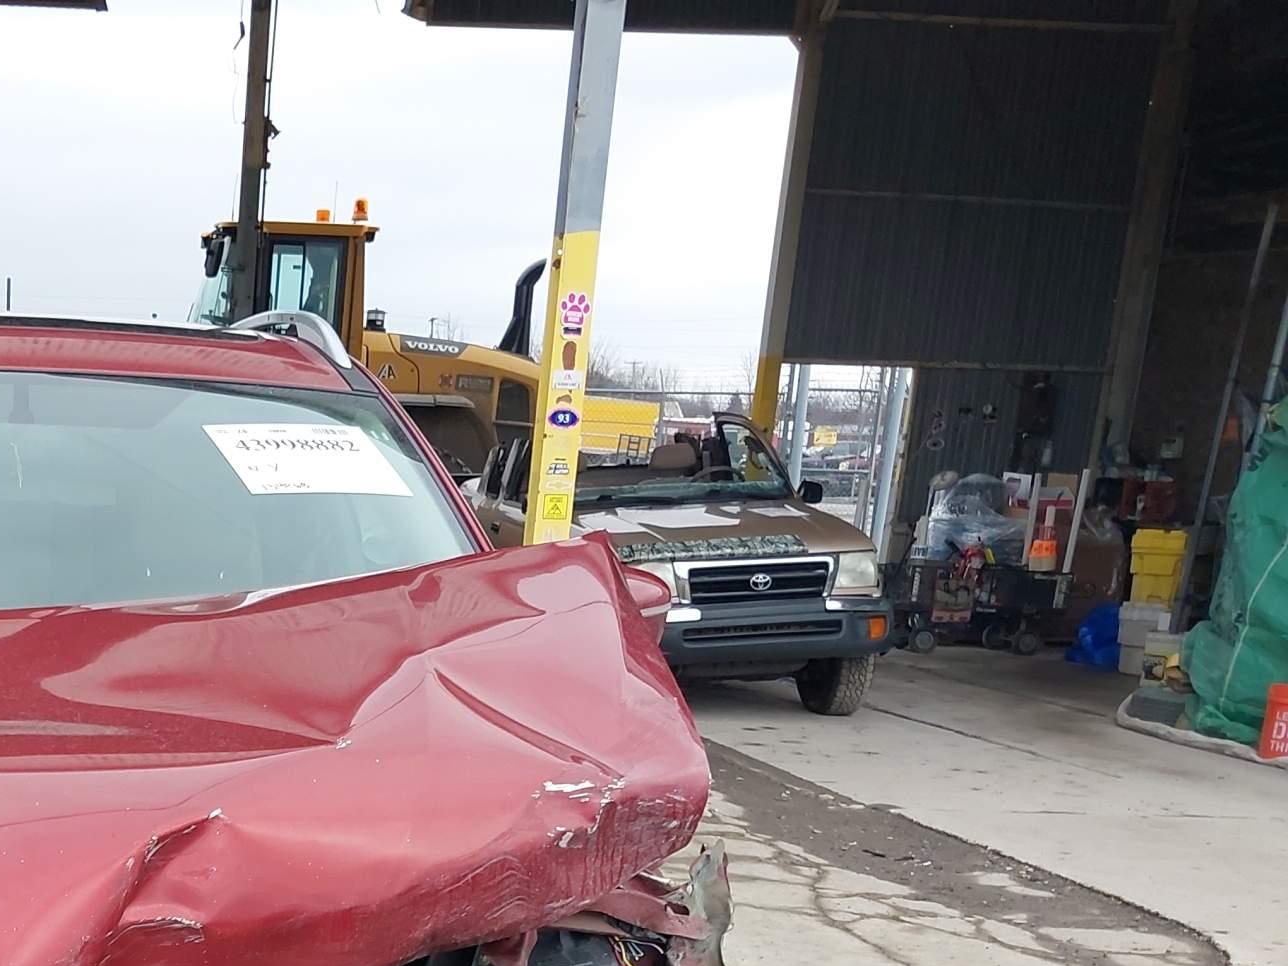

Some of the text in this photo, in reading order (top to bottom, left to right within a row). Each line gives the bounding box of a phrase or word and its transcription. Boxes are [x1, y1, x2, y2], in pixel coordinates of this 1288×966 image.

[405, 340, 459, 354] VOLVO
[557, 413, 570, 424] 93
[235, 438, 361, 452] 43998882
